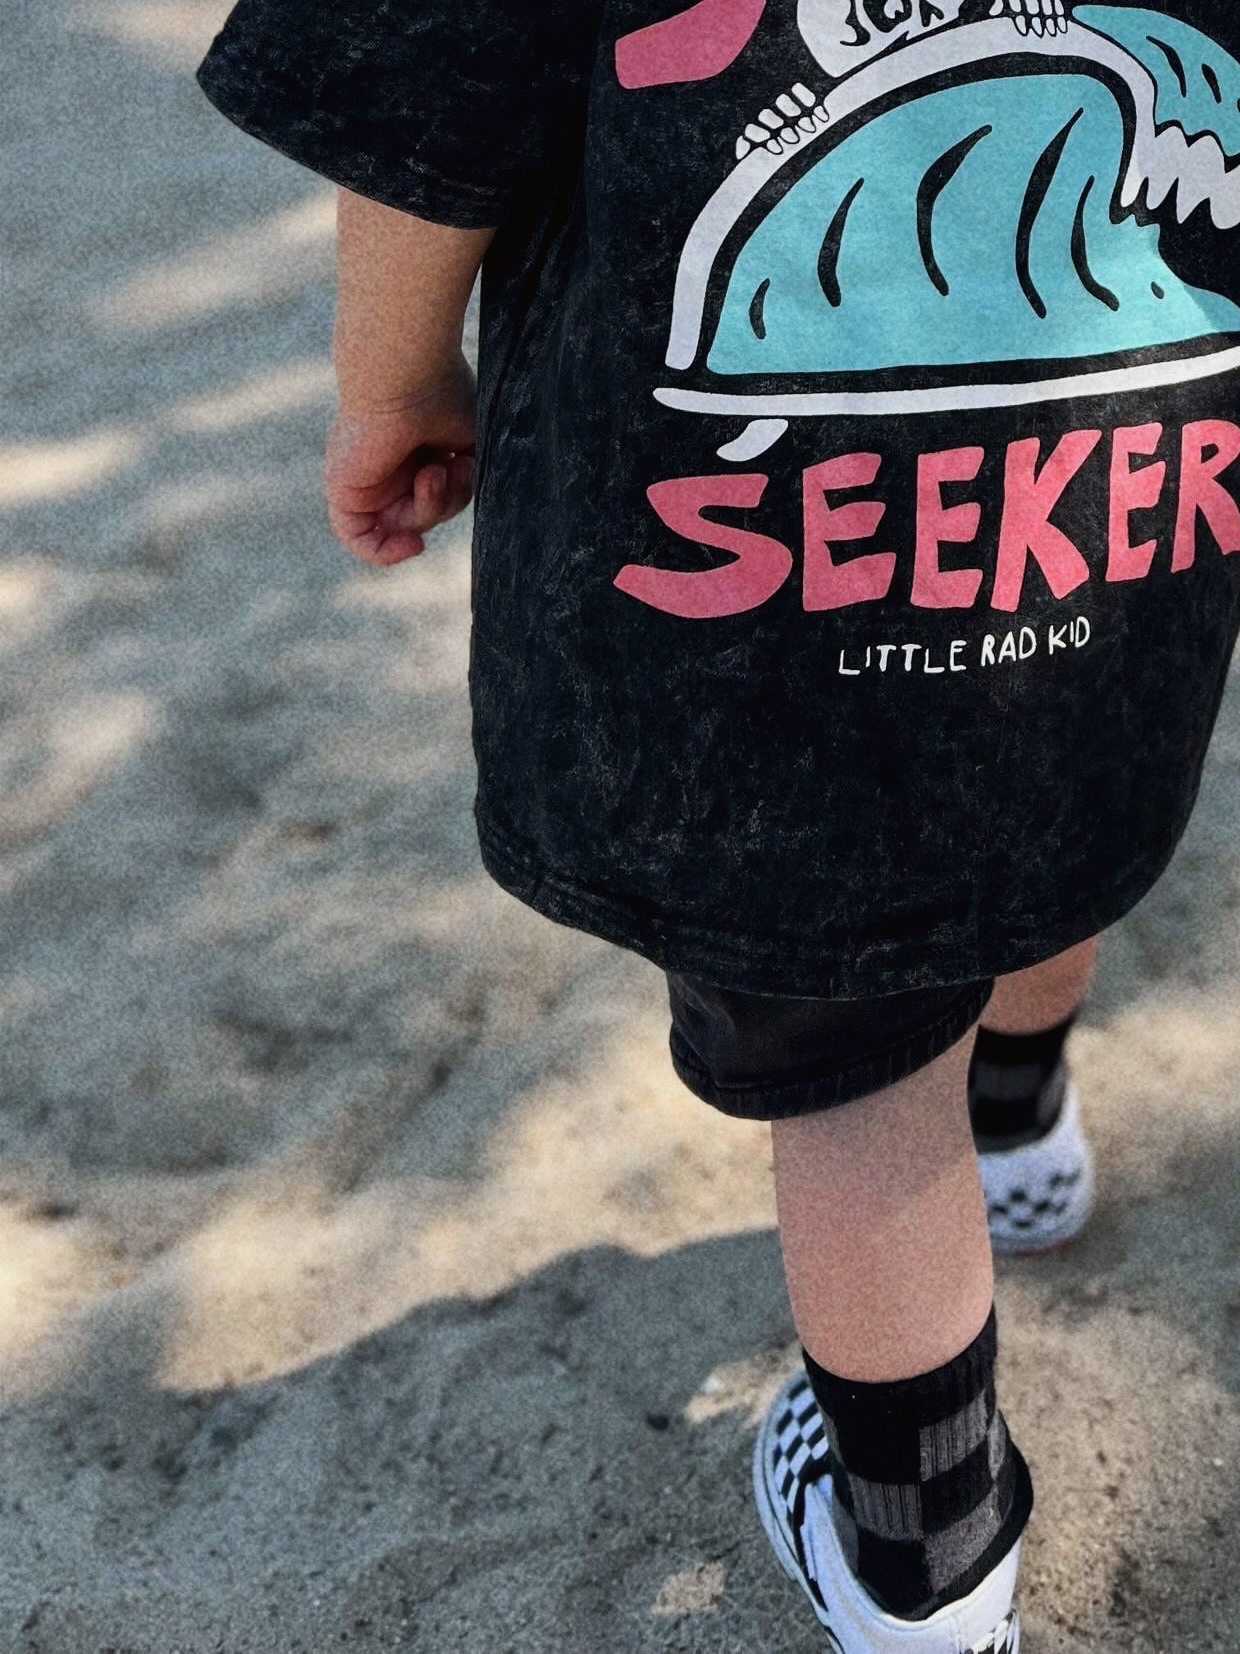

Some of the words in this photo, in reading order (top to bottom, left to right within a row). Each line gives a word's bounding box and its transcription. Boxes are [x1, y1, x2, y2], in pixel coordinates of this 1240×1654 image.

[838, 639, 967, 676] LITTLE
[980, 626, 1038, 667] RAD
[1048, 615, 1091, 655] KID
